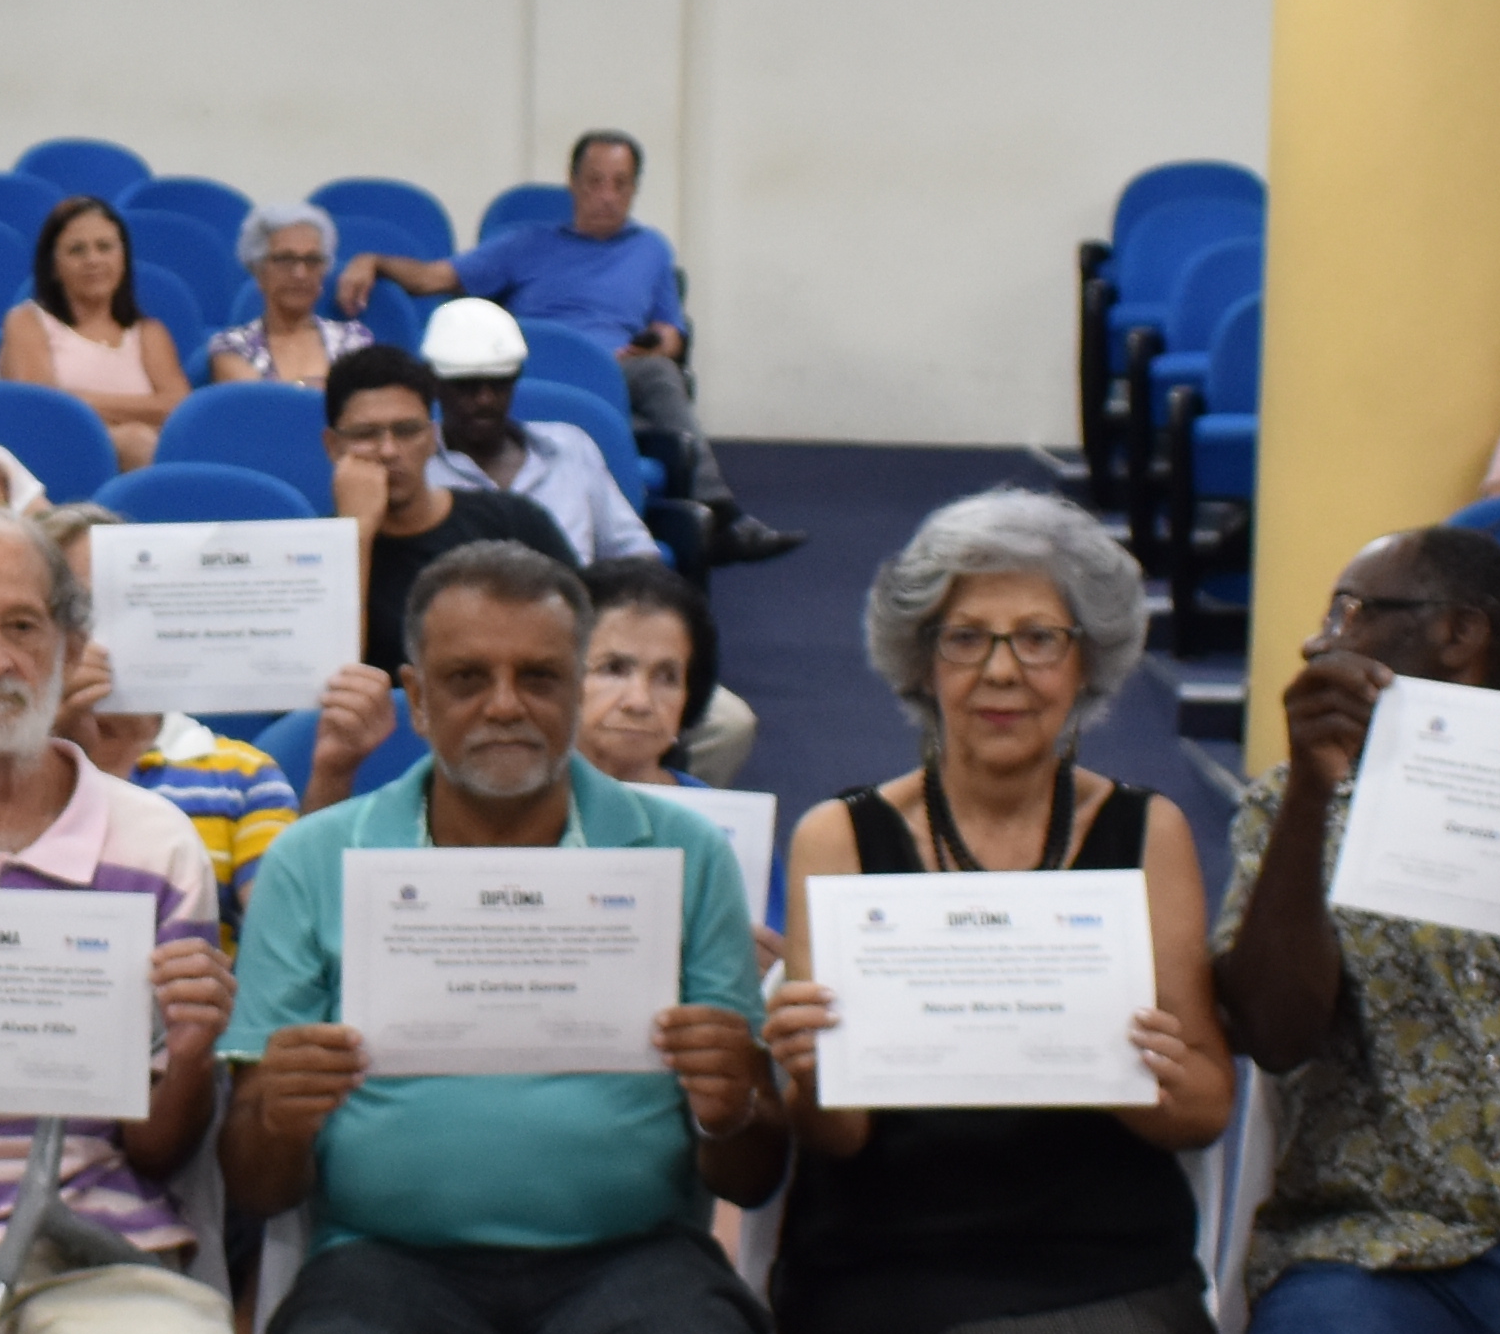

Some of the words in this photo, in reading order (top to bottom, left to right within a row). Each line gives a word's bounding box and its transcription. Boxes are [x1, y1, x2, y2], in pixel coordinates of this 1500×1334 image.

[201, 553, 250, 568] DIPLOMA
[480, 891, 544, 908] DIPLOMA
[948, 912, 1010, 928] DIPLOMA
[478, 981, 524, 993] Carlos
[972, 1001, 1012, 1014] Maria
[0, 1021, 38, 1034] Alves
[42, 1023, 76, 1035] Filho
